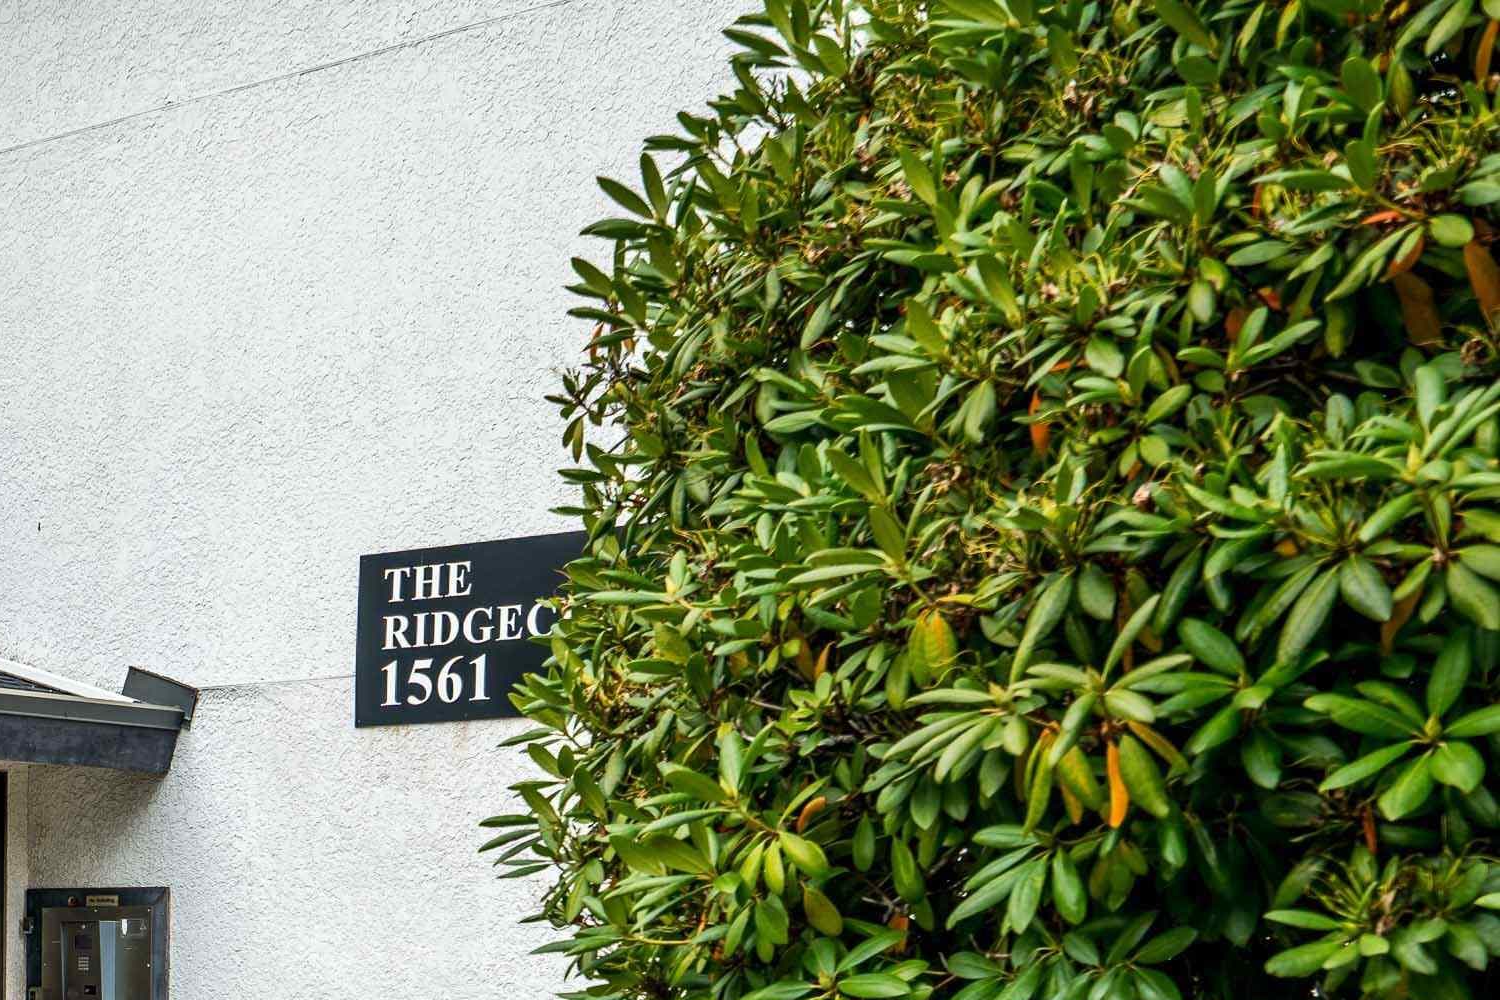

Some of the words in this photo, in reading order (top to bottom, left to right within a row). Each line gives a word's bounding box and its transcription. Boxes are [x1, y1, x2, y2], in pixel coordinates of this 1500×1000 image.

[383, 560, 473, 604] THE
[381, 604, 572, 651] RIDGEC
[380, 653, 491, 708] 1561
